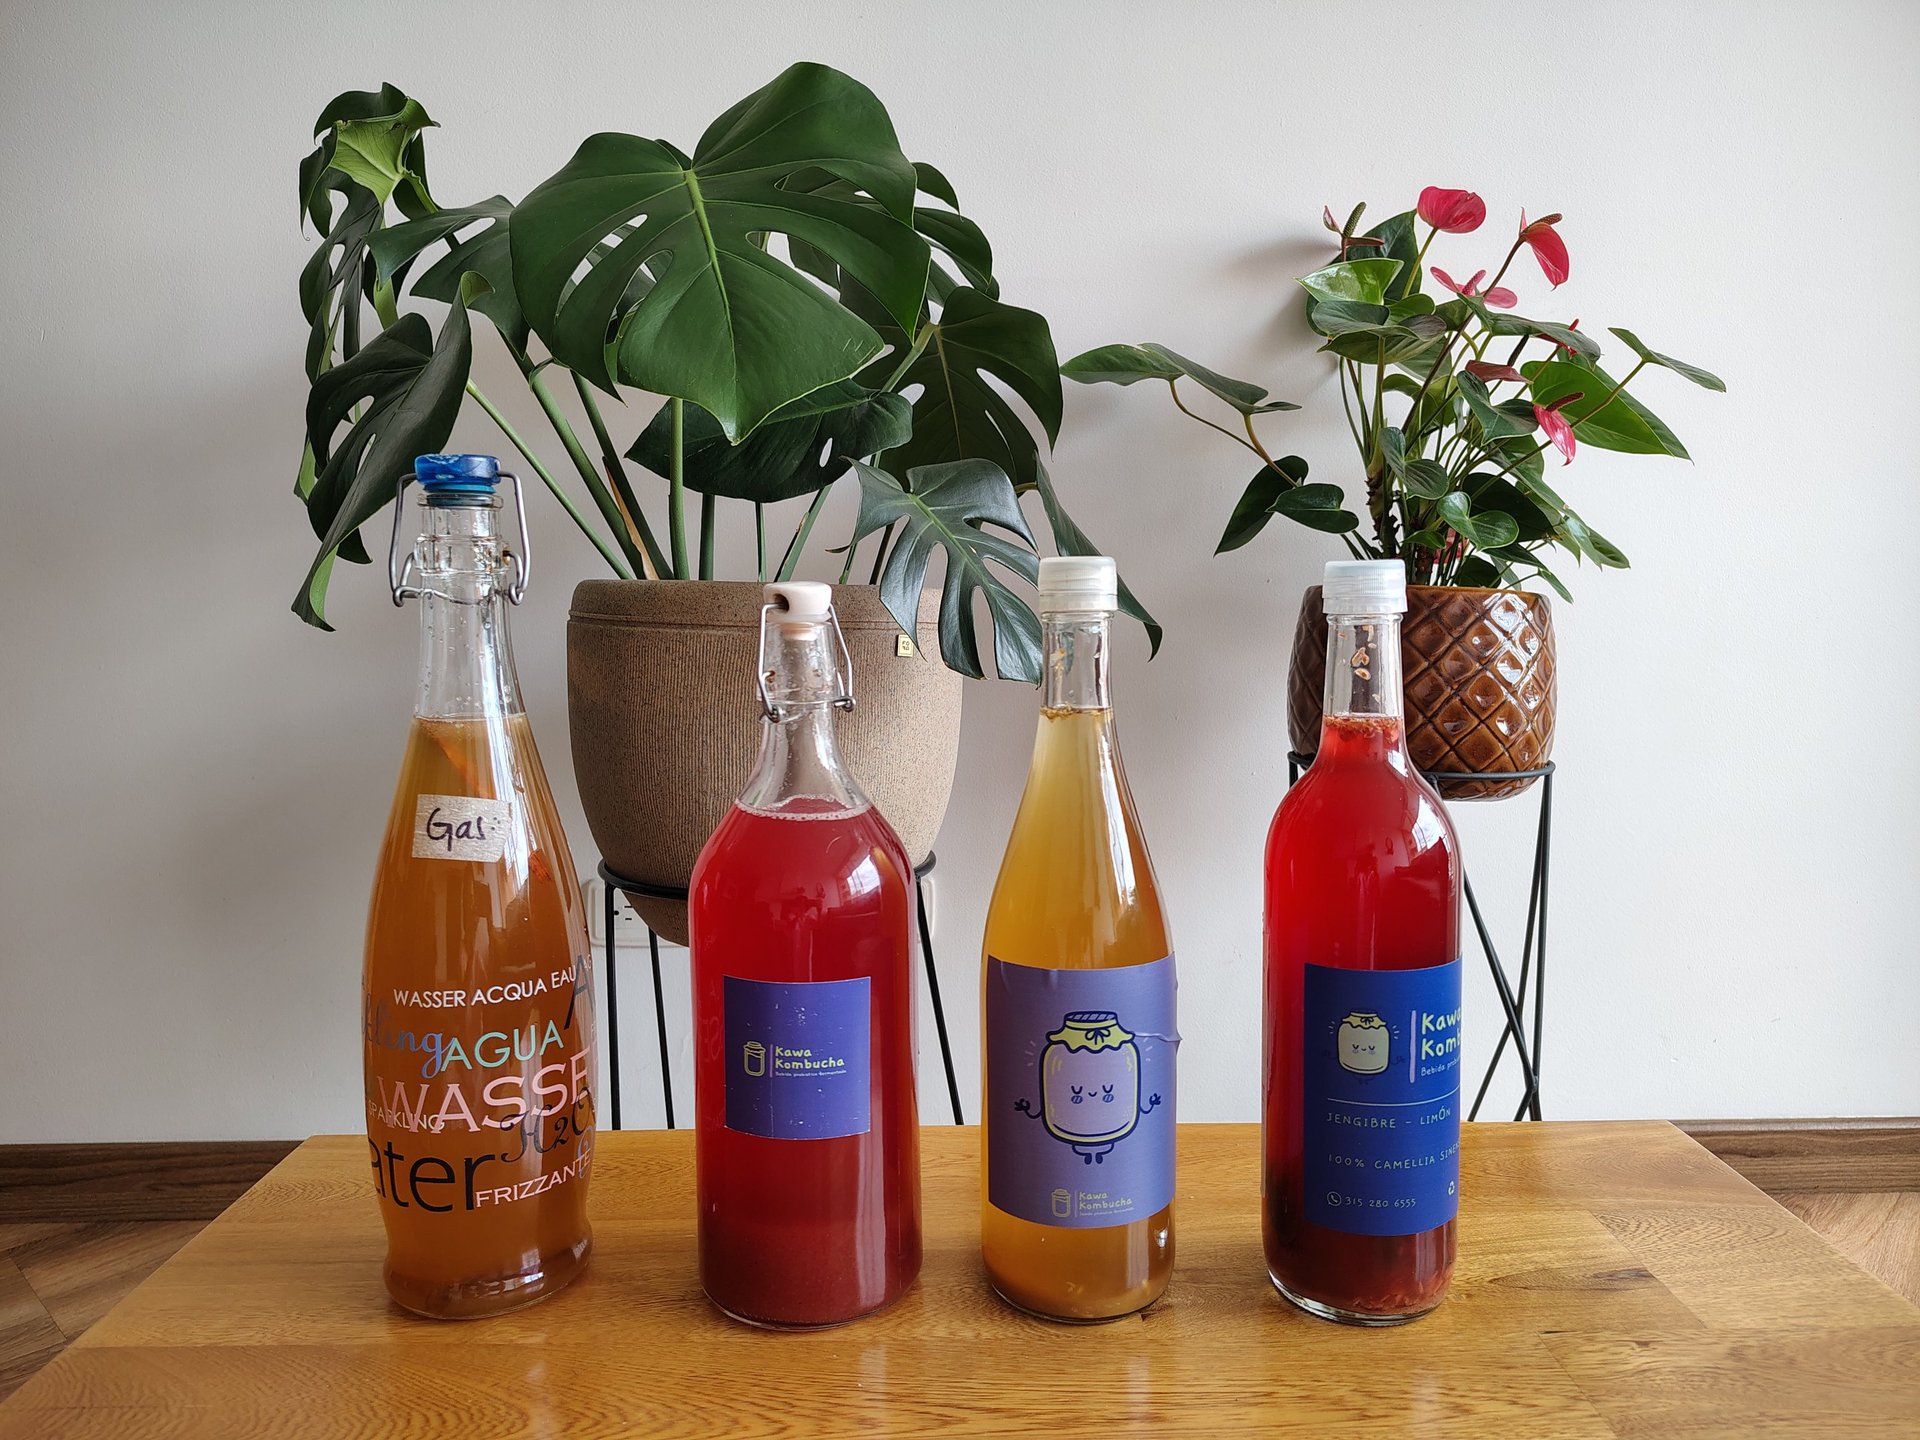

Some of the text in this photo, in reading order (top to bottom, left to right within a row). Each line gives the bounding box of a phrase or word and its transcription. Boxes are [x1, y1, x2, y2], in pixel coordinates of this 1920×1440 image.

[393, 965, 577, 1009] WASSER ACQUA EAU
[441, 1019, 564, 1072] AGUA
[775, 1046, 812, 1057] Kawa
[775, 1057, 845, 1070] Kombucha
[1327, 1112, 1396, 1128] JENGIBRE
[1420, 1105, 1451, 1125] LIMÓN
[1328, 1154, 1365, 1168] 100%
[1374, 1156, 1436, 1170] CAMELLIA
[475, 1148, 592, 1208] FRIZZANTE
[1079, 1191, 1109, 1201] Kawa
[1345, 1196, 1417, 1209] 315 280 6555
[1079, 1198, 1133, 1211] Kombucha
